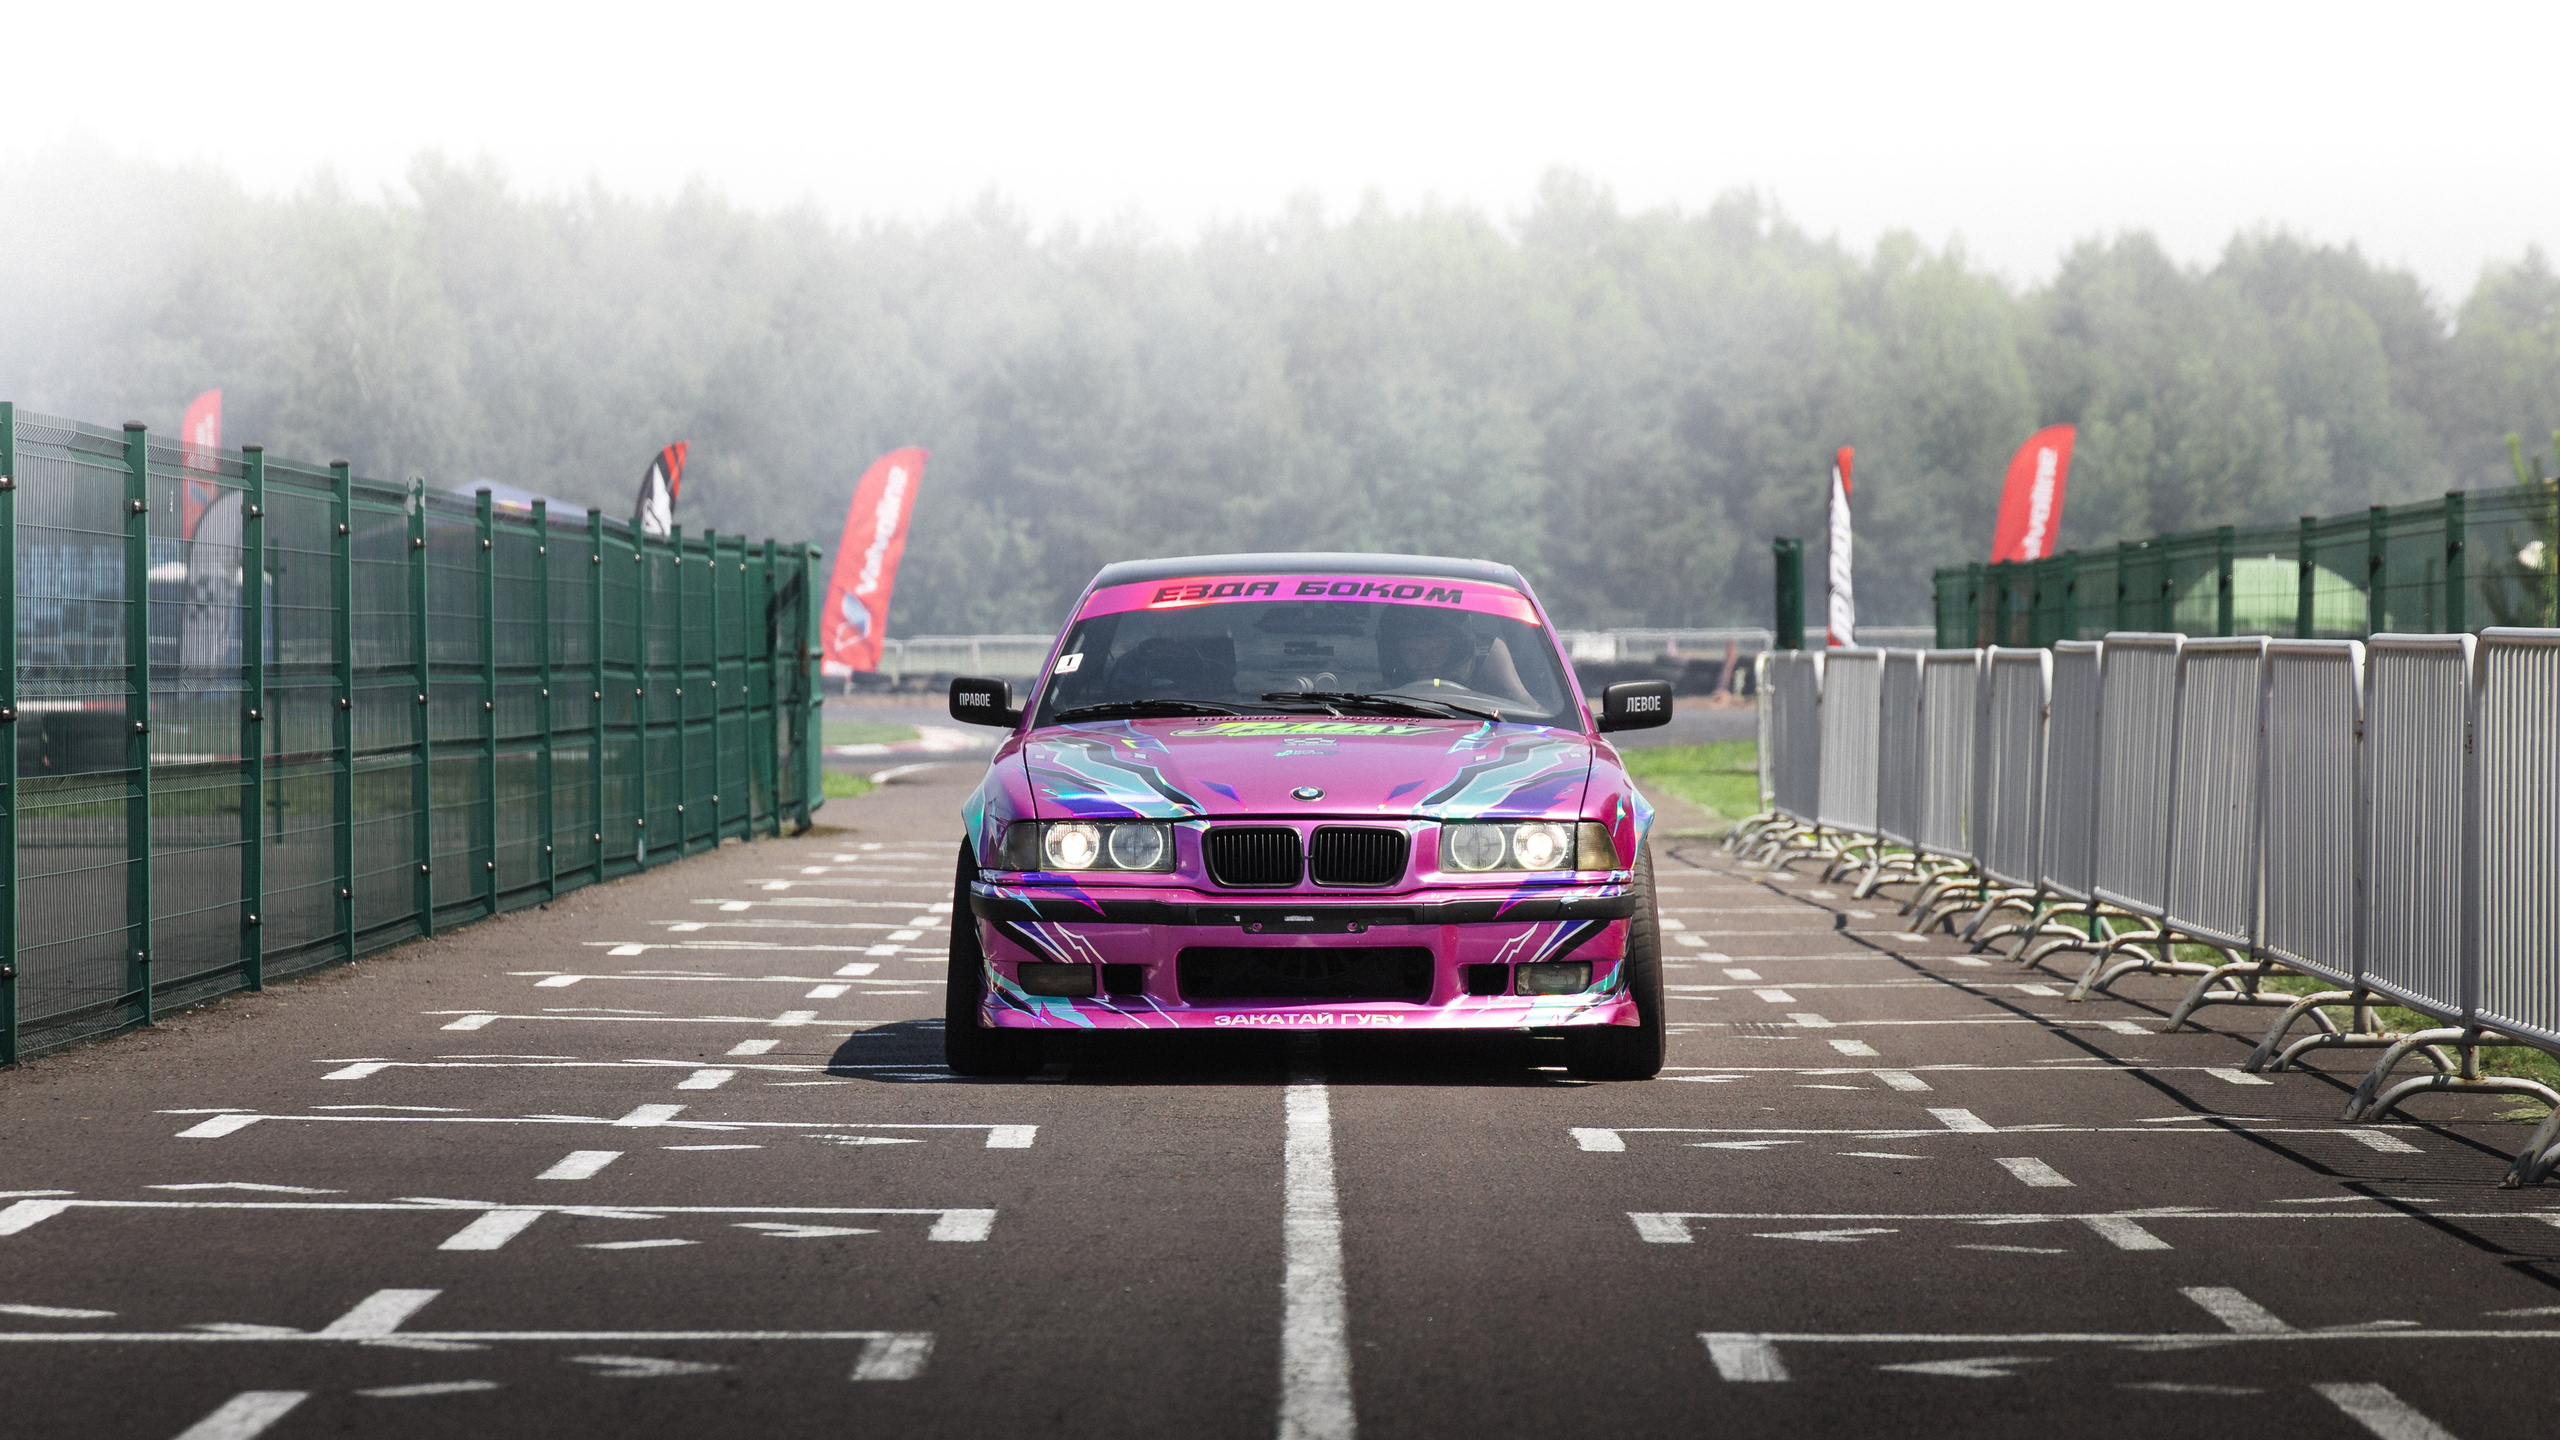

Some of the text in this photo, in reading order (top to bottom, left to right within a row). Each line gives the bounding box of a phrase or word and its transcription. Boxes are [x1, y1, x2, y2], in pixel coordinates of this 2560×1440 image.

[2022, 446, 2058, 562] alvoline
[1152, 580, 1464, 604] ЕЗДА БОКОМ
[1066, 656, 1074, 667] 1
[959, 692, 991, 707] ПРАВОЕ
[1625, 695, 1661, 713] ЛЕВОЕ
[1214, 1012, 1405, 1026] ЗАКАТАЙ ГУБУ
